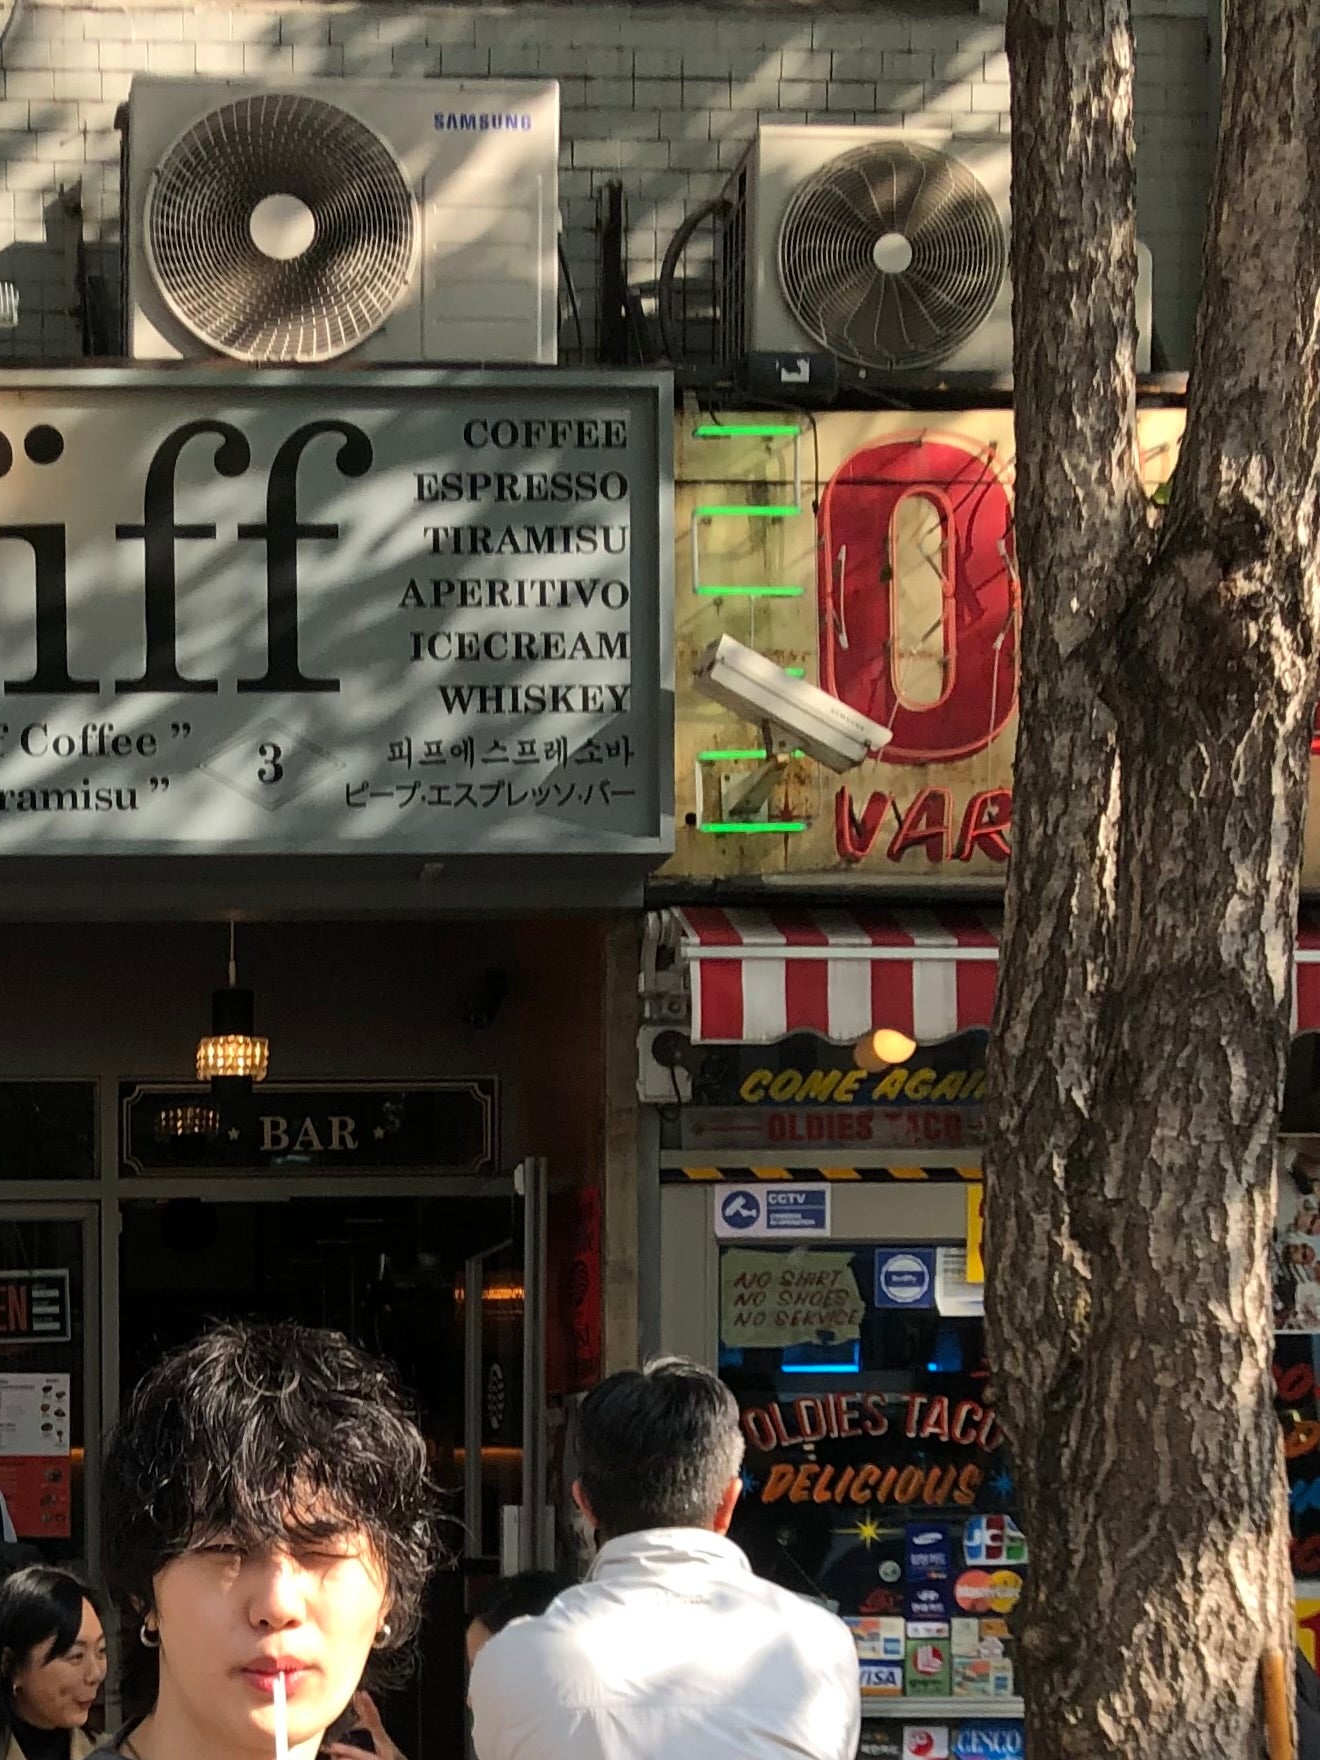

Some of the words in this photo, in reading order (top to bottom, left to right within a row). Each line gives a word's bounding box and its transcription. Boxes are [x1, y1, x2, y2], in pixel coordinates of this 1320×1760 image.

[433, 111, 532, 130] SAMSUNG
[463, 418, 628, 450] COFFEE
[413, 471, 629, 503] ESPRESSO
[424, 524, 629, 554] TIRAMISU
[399, 577, 630, 610] APERITIVO
[410, 631, 630, 662] ICECREAM
[438, 684, 632, 716] WHISKEY
[256, 742, 284, 784] 3
[739, 1068, 868, 1103] COME
[259, 1115, 359, 1152] BAR
[766, 1111, 875, 1142] OLDIES
[768, 1193, 806, 1204] CCTV
[733, 1271, 772, 1290] NO
[779, 1269, 843, 1288] SHIRT
[734, 1290, 768, 1308] NO
[778, 1289, 851, 1309] SHOES
[733, 1310, 767, 1328] NO
[774, 1308, 860, 1328] SERVICE
[740, 1391, 889, 1452] OLDIES
[761, 1463, 982, 1505] DELICIOUS
